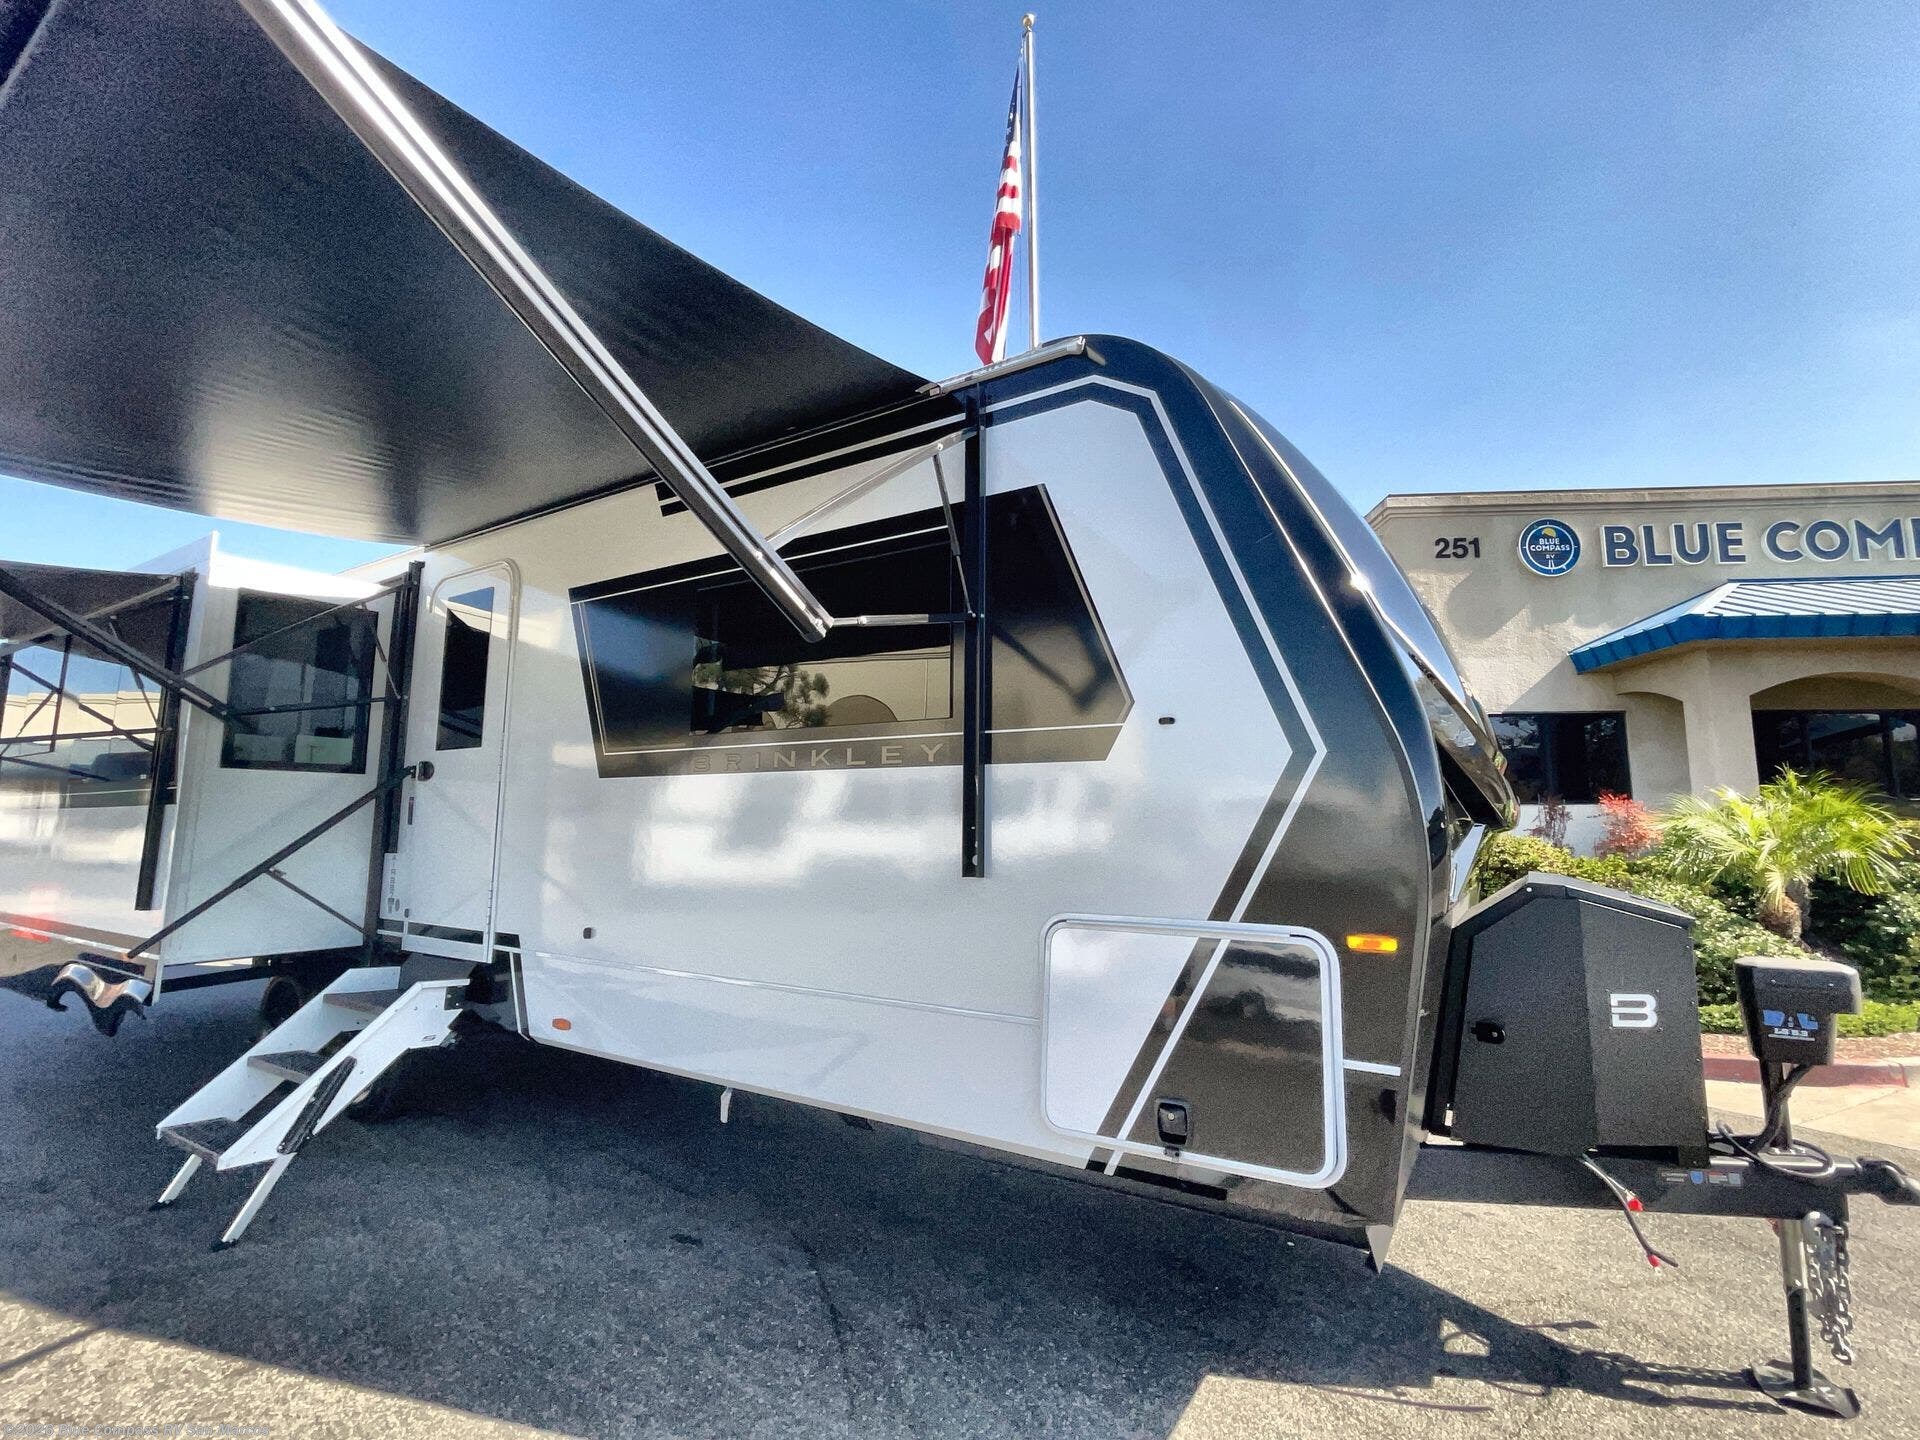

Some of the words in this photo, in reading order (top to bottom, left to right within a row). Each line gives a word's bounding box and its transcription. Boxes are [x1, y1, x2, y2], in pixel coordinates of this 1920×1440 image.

[1434, 537, 1480, 558] 251
[1601, 522, 1747, 567] BLUE
[1761, 517, 1920, 563] COM
[694, 743, 944, 771] BRINKLEY
